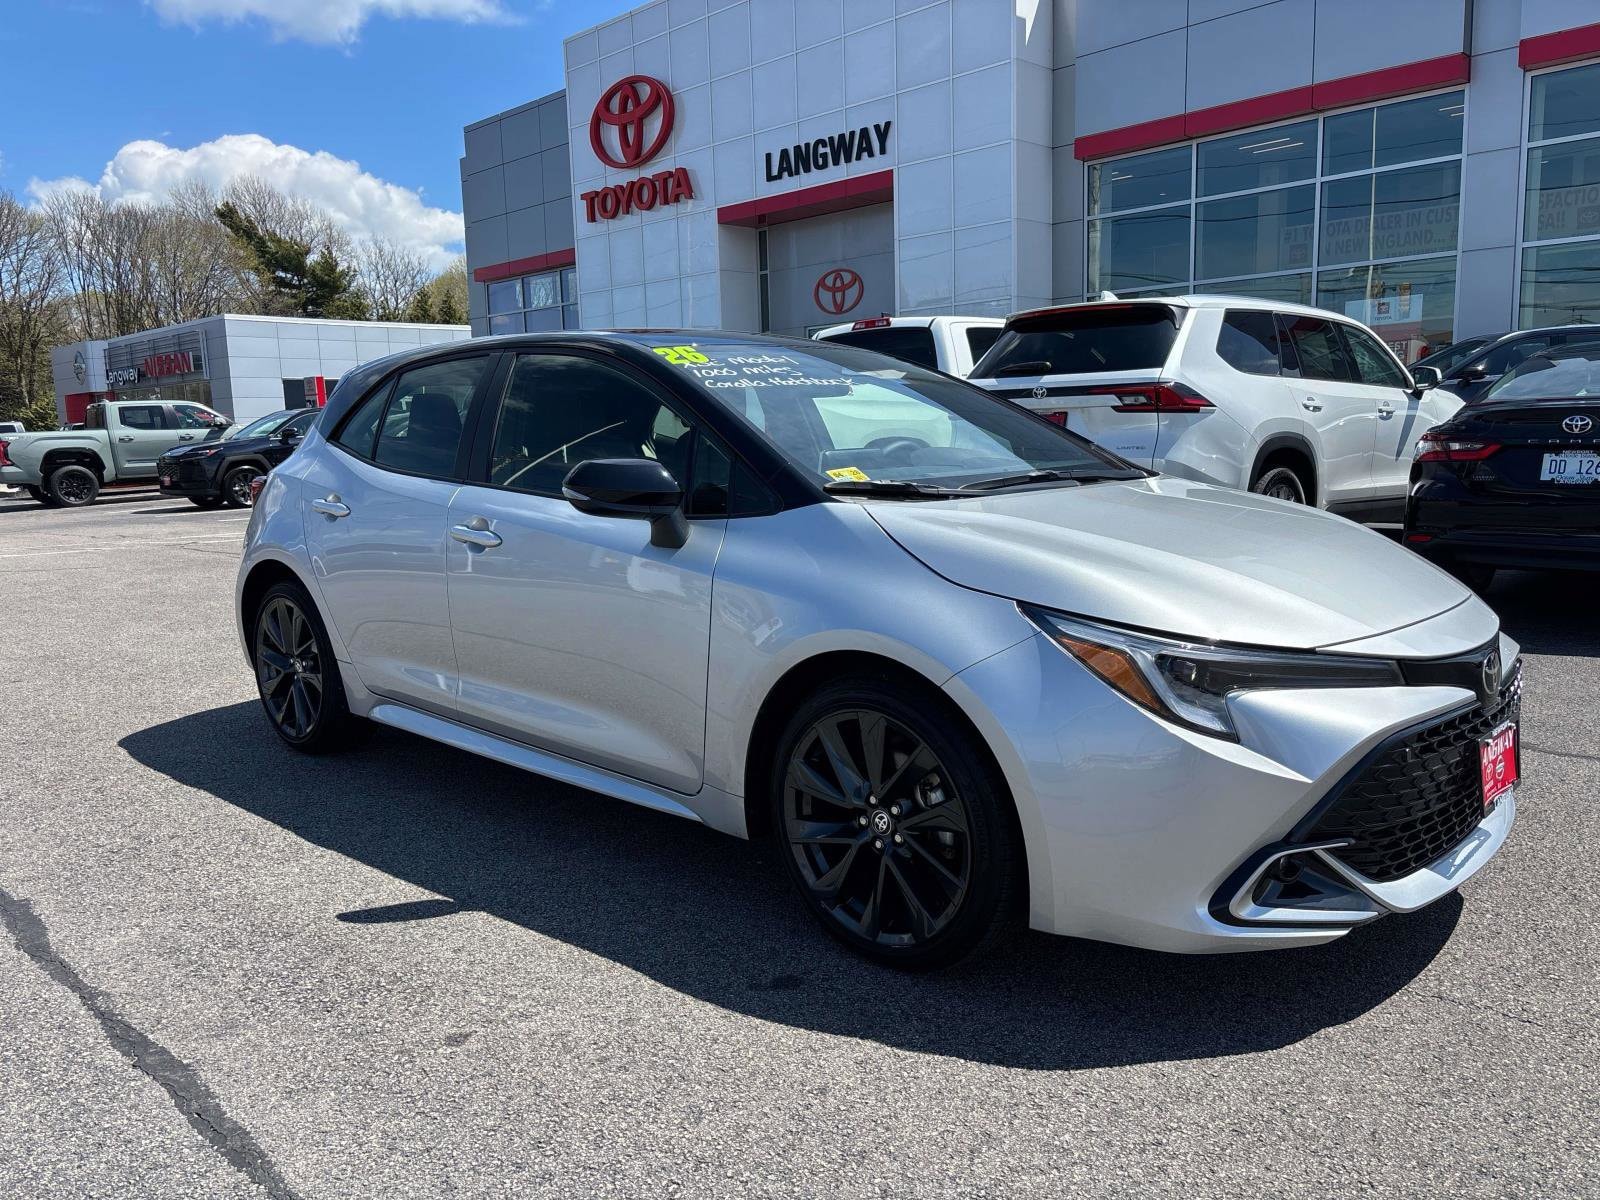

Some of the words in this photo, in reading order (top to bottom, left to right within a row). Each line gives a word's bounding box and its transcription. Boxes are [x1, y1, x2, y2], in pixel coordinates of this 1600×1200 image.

[765, 120, 892, 182] LANGWAY
[580, 167, 695, 223] TOYOTA
[1302, 221, 1351, 242] TOOTA
[1354, 213, 1402, 233] DEALER
[1406, 211, 1422, 228] IN
[1335, 237, 1364, 256] NEW
[143, 351, 195, 378] NISSAN
[652, 345, 710, 365] 26
[105, 367, 139, 385] Langway
[704, 378, 769, 388] Corolla
